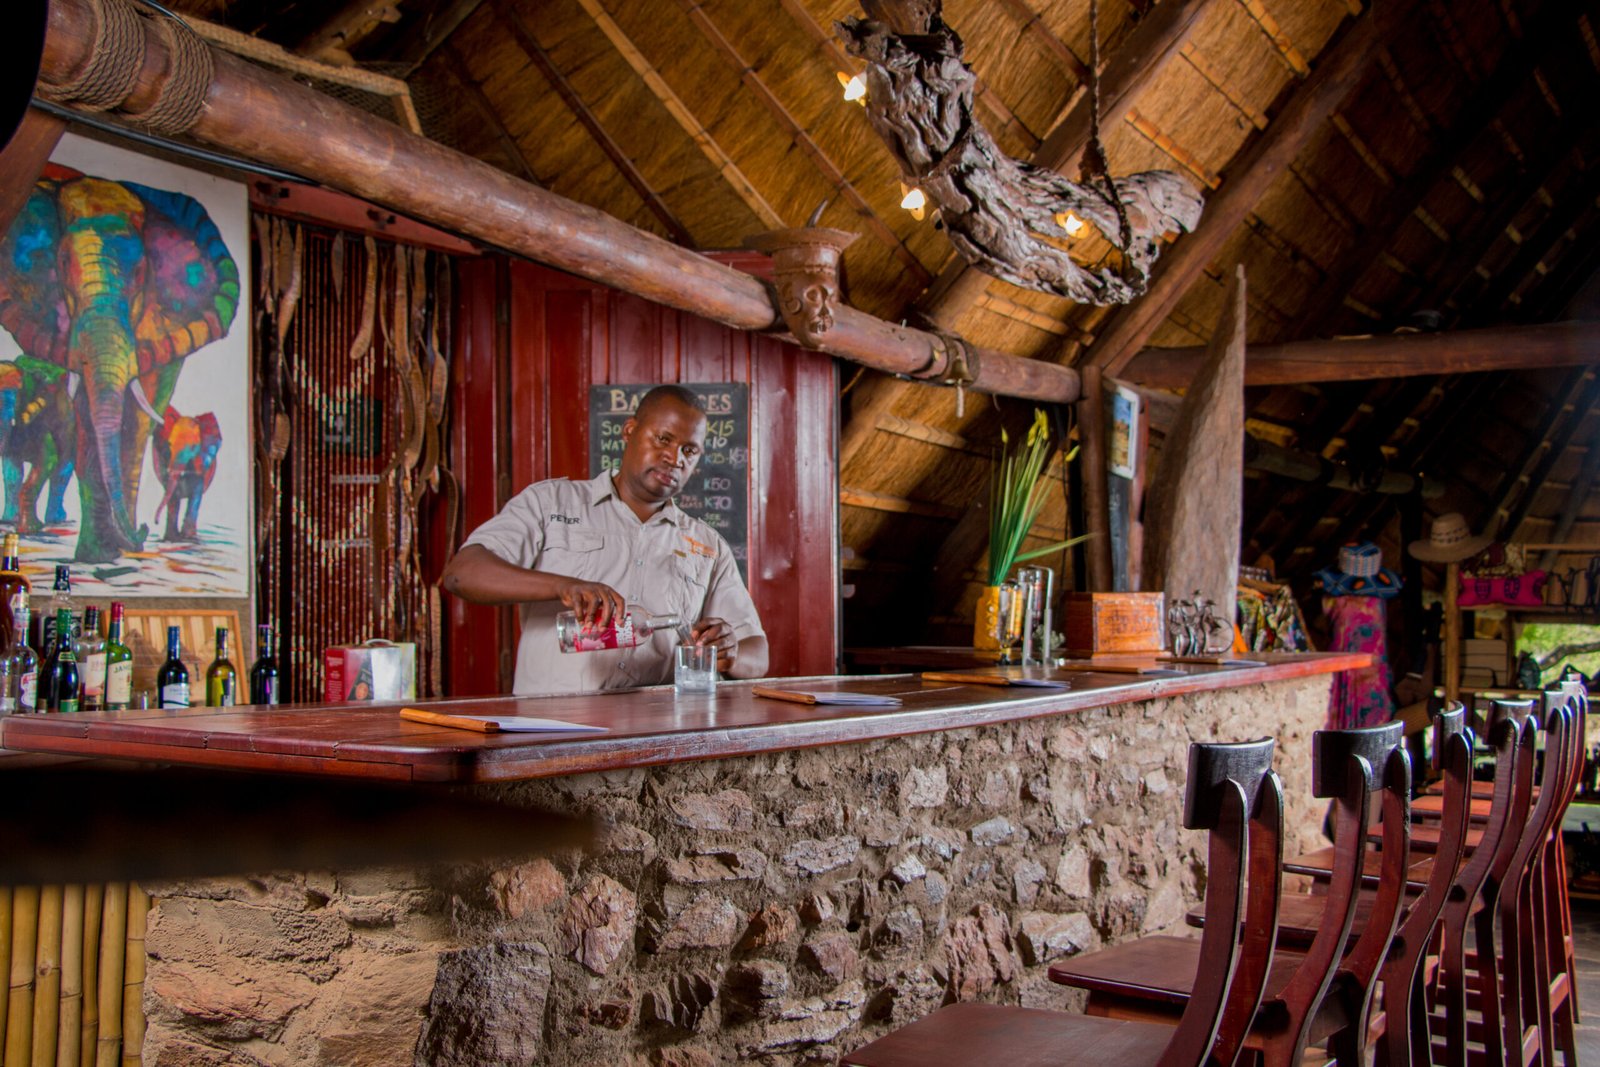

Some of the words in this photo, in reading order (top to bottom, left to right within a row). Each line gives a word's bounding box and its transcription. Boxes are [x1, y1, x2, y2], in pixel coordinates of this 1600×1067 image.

[706, 420, 735, 437] K15
[600, 439, 626, 451] WAT
[600, 455, 622, 469] BE
[550, 514, 580, 525] PETER
